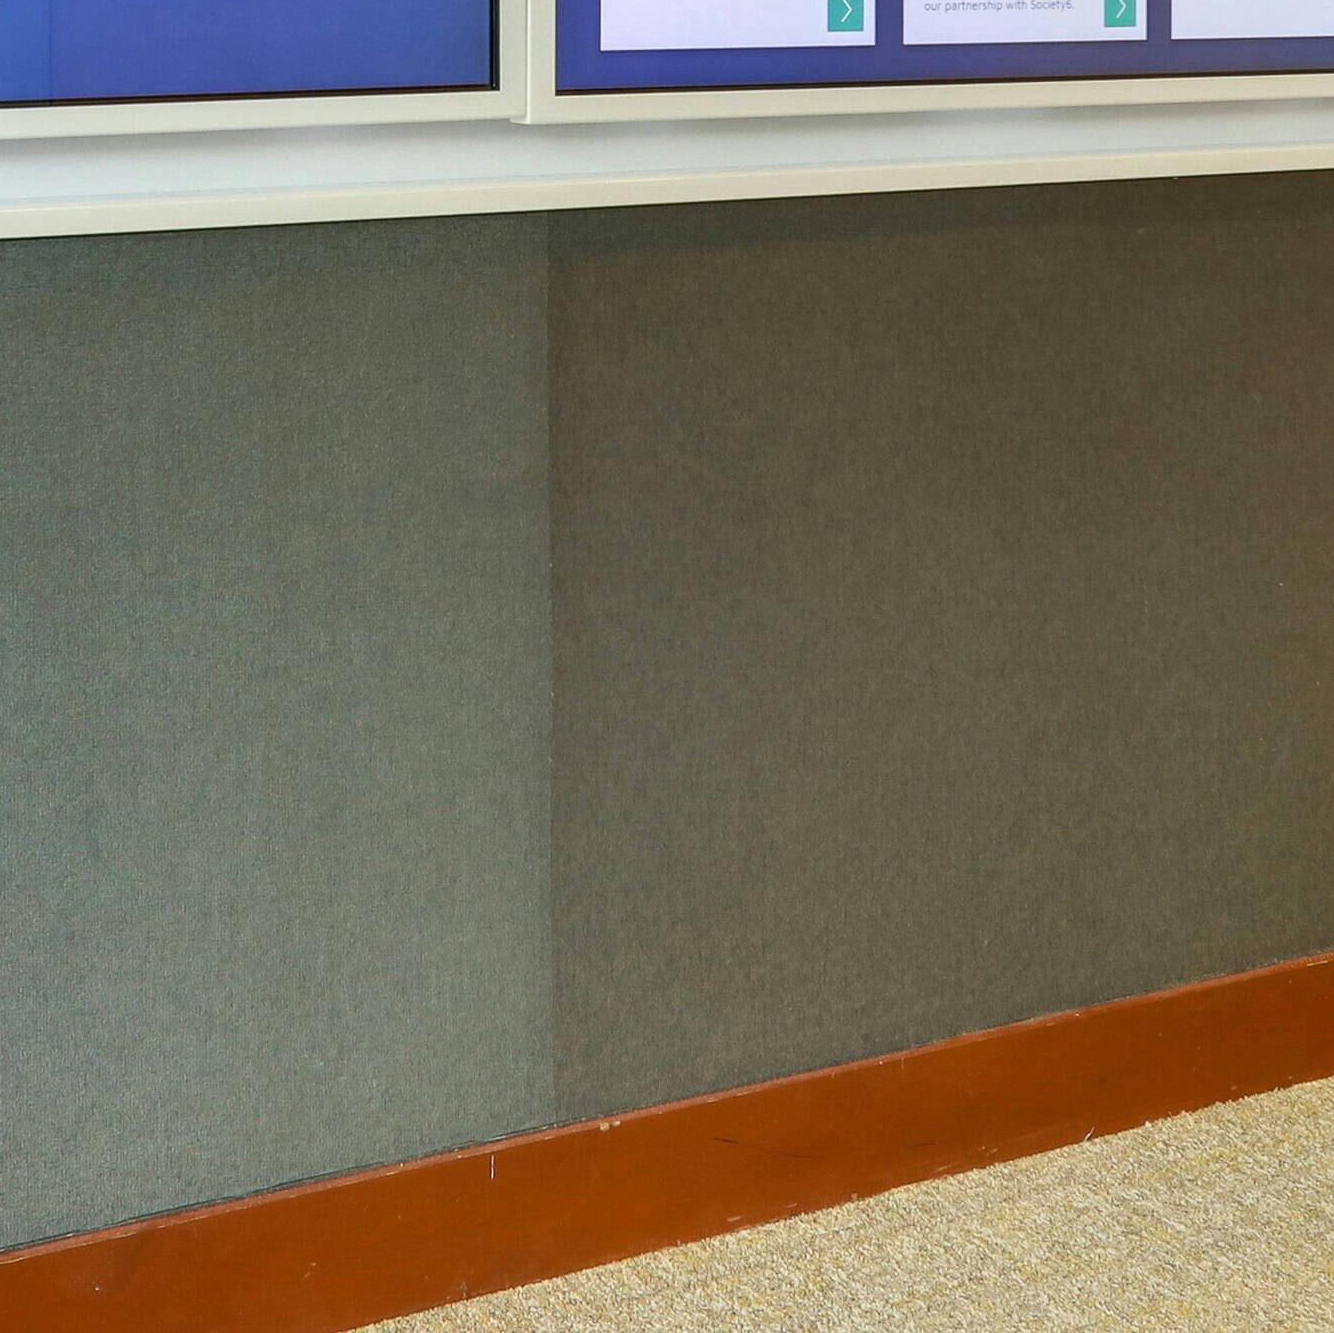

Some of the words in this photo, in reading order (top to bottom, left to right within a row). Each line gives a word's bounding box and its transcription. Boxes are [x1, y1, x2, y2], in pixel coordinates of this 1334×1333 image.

[924, 2, 942, 11] our
[945, 1, 1003, 14] partnership
[1006, 0, 1028, 11] with
